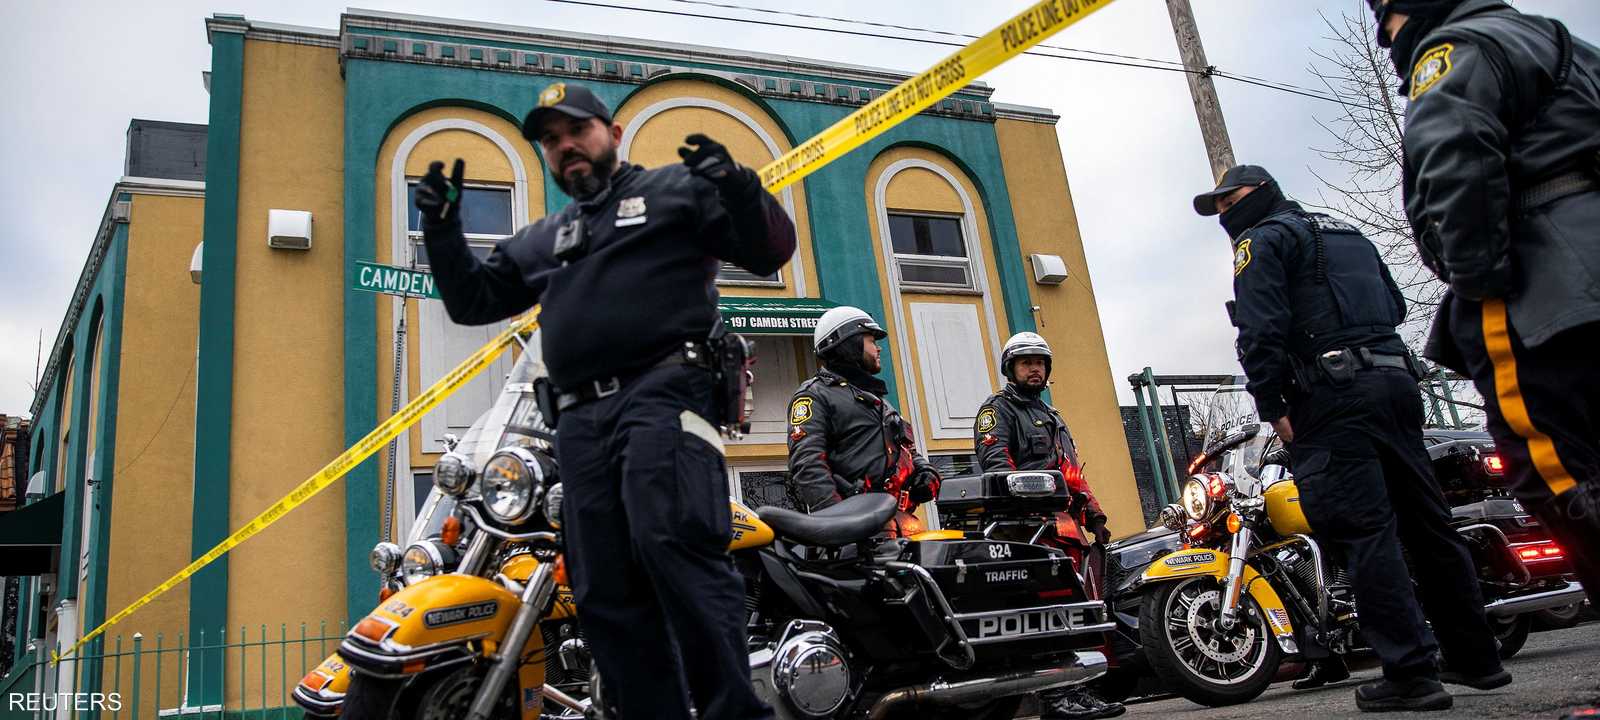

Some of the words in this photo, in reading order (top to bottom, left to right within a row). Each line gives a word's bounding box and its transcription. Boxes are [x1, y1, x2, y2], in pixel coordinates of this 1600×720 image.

[1000, 12, 1038, 52] POLICE
[1035, 0, 1064, 32] LINE
[855, 104, 883, 137] POLICE
[882, 91, 902, 120] LINE
[901, 84, 916, 109] DO
[915, 73, 934, 101] NOT
[933, 55, 966, 90] CROSS
[800, 138, 825, 168] CROSS
[360, 266, 434, 294] CAMDEN
[730, 316, 747, 328] 197
[750, 317, 788, 328] CAMDEN
[790, 317, 818, 328] STREE
[1220, 413, 1253, 431] POLICE
[988, 543, 1012, 559] 824
[1166, 556, 1193, 566] NEWARK
[1193, 553, 1214, 563] POLICE
[985, 569, 1028, 582] TRAFFIC
[428, 610, 466, 625] NEWARK
[467, 603, 496, 617] POLICE
[979, 608, 1085, 638] POLICE
